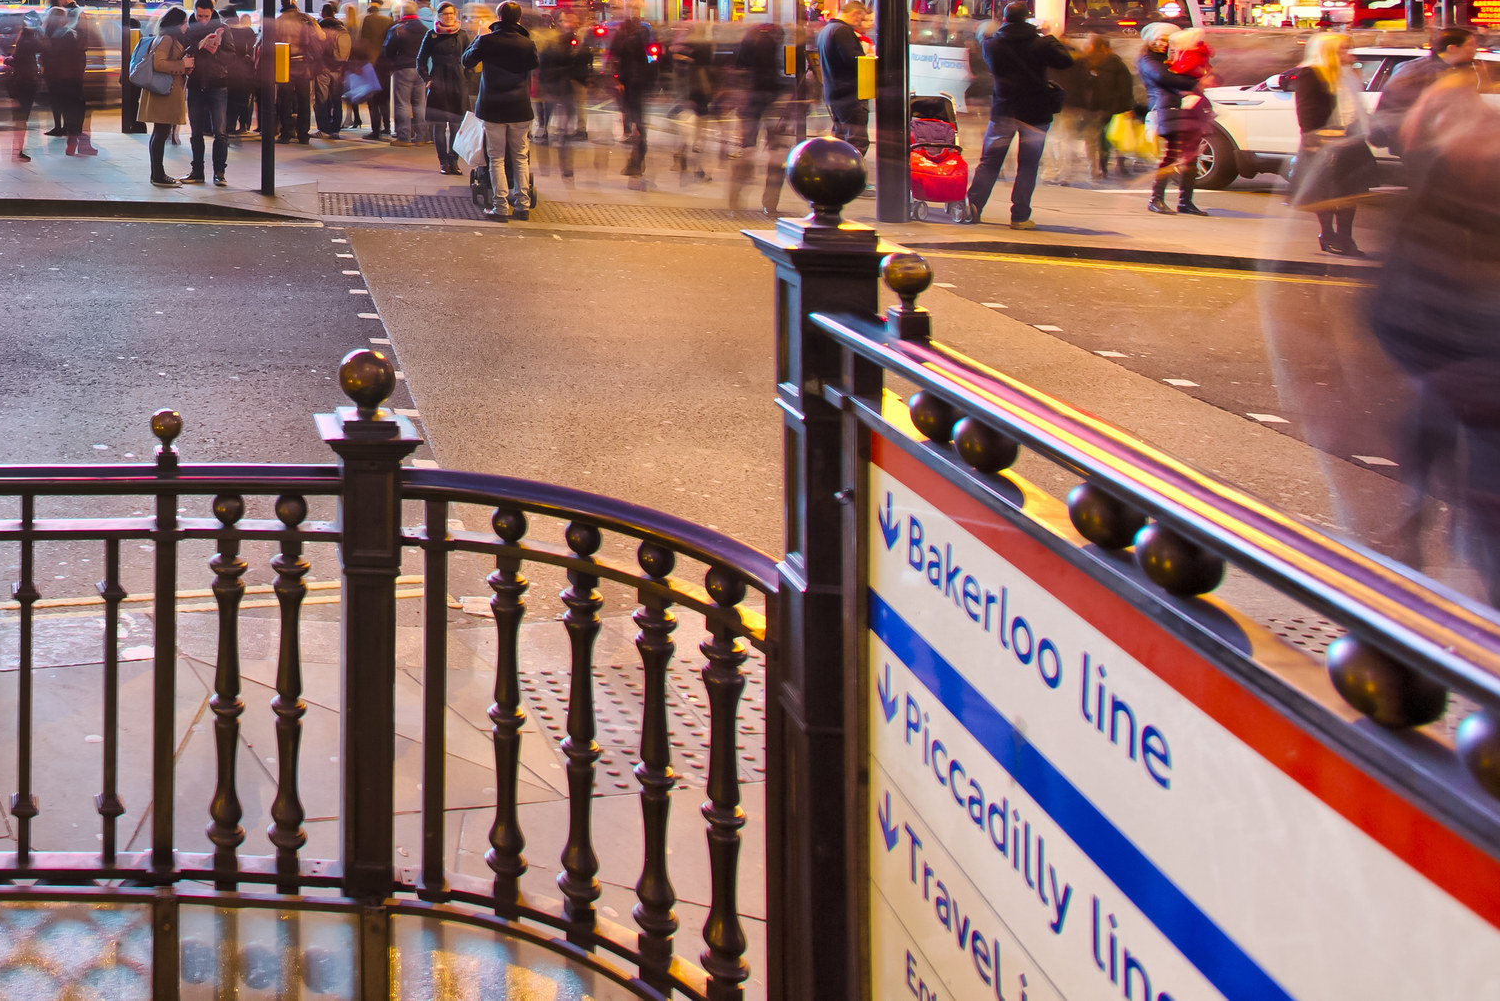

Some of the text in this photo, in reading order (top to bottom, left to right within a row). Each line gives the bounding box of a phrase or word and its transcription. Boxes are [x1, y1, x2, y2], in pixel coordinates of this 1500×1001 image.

[907, 514, 1173, 791] Bakerloo line
[903, 691, 1074, 936] Piccadilly
[903, 821, 1005, 1001] Travel
